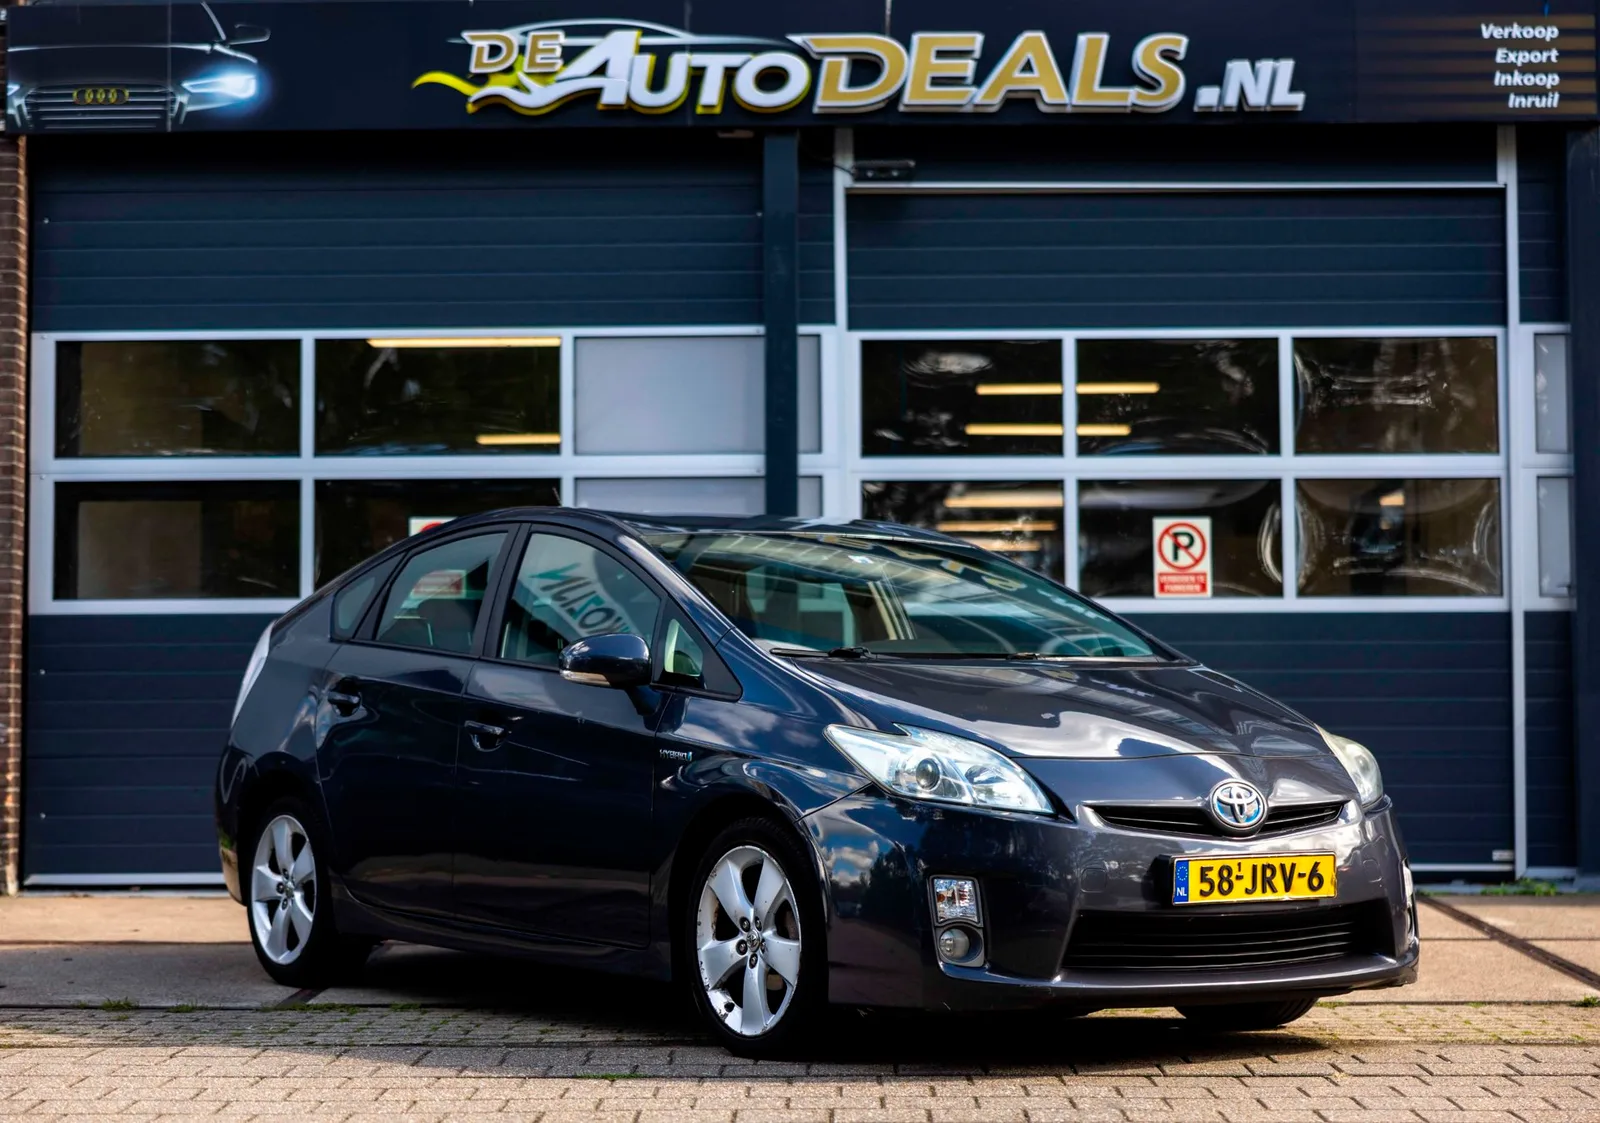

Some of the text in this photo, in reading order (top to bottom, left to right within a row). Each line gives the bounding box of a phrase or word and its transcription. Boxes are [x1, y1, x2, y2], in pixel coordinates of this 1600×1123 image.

[1481, 22, 1559, 41] Verkoop
[461, 30, 566, 75] DE
[1495, 47, 1559, 67] Export
[1493, 69, 1560, 89] Inkoop
[1508, 91, 1560, 108] Inruil
[1176, 887, 1187, 897] NL
